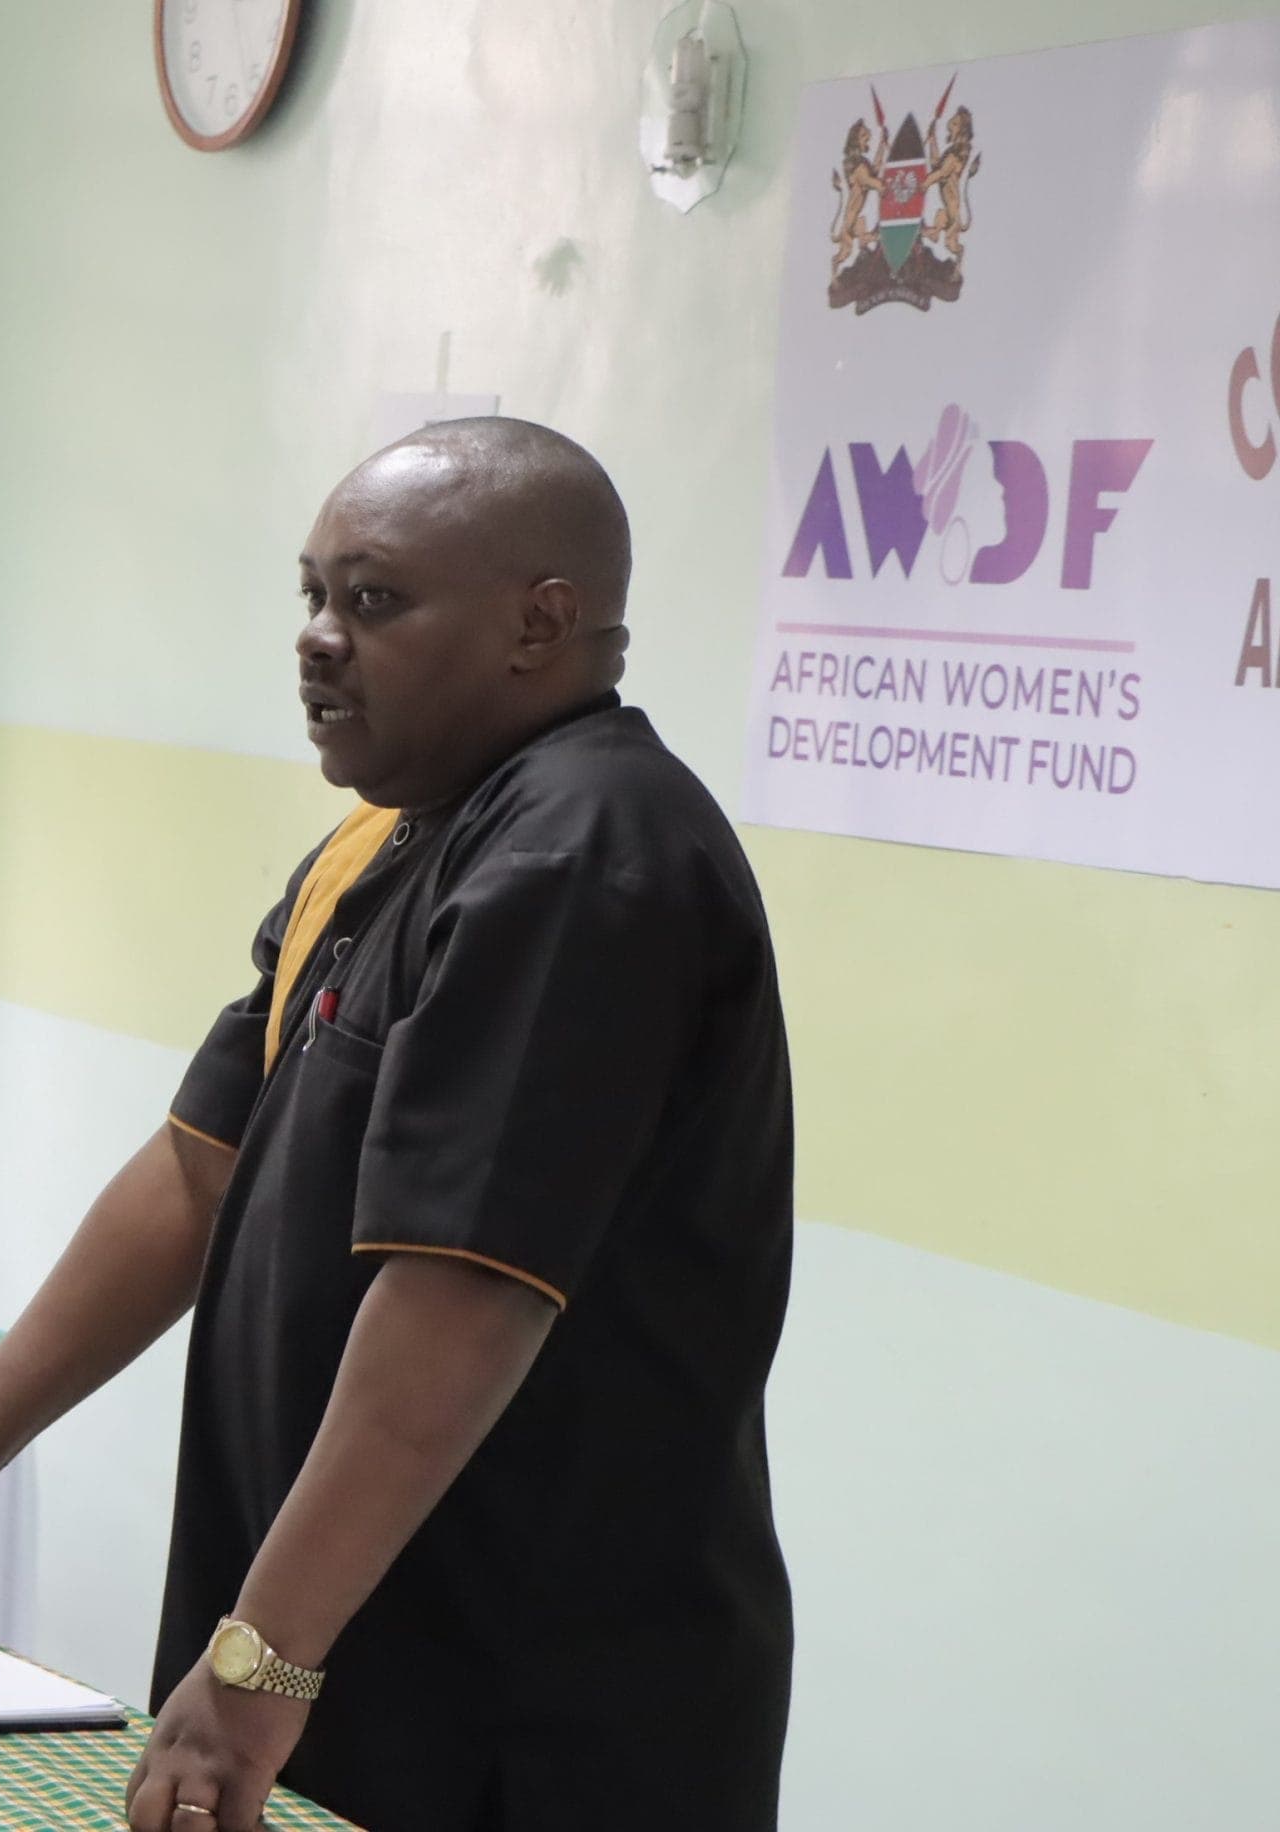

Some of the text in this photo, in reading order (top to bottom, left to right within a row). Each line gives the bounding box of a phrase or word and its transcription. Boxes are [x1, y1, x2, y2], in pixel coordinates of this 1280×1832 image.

[1234, 577, 1280, 689] A
[770, 650, 1141, 721] AFRICAN WOMEN'S
[767, 715, 1136, 795] DEVELOPMENT FUND
